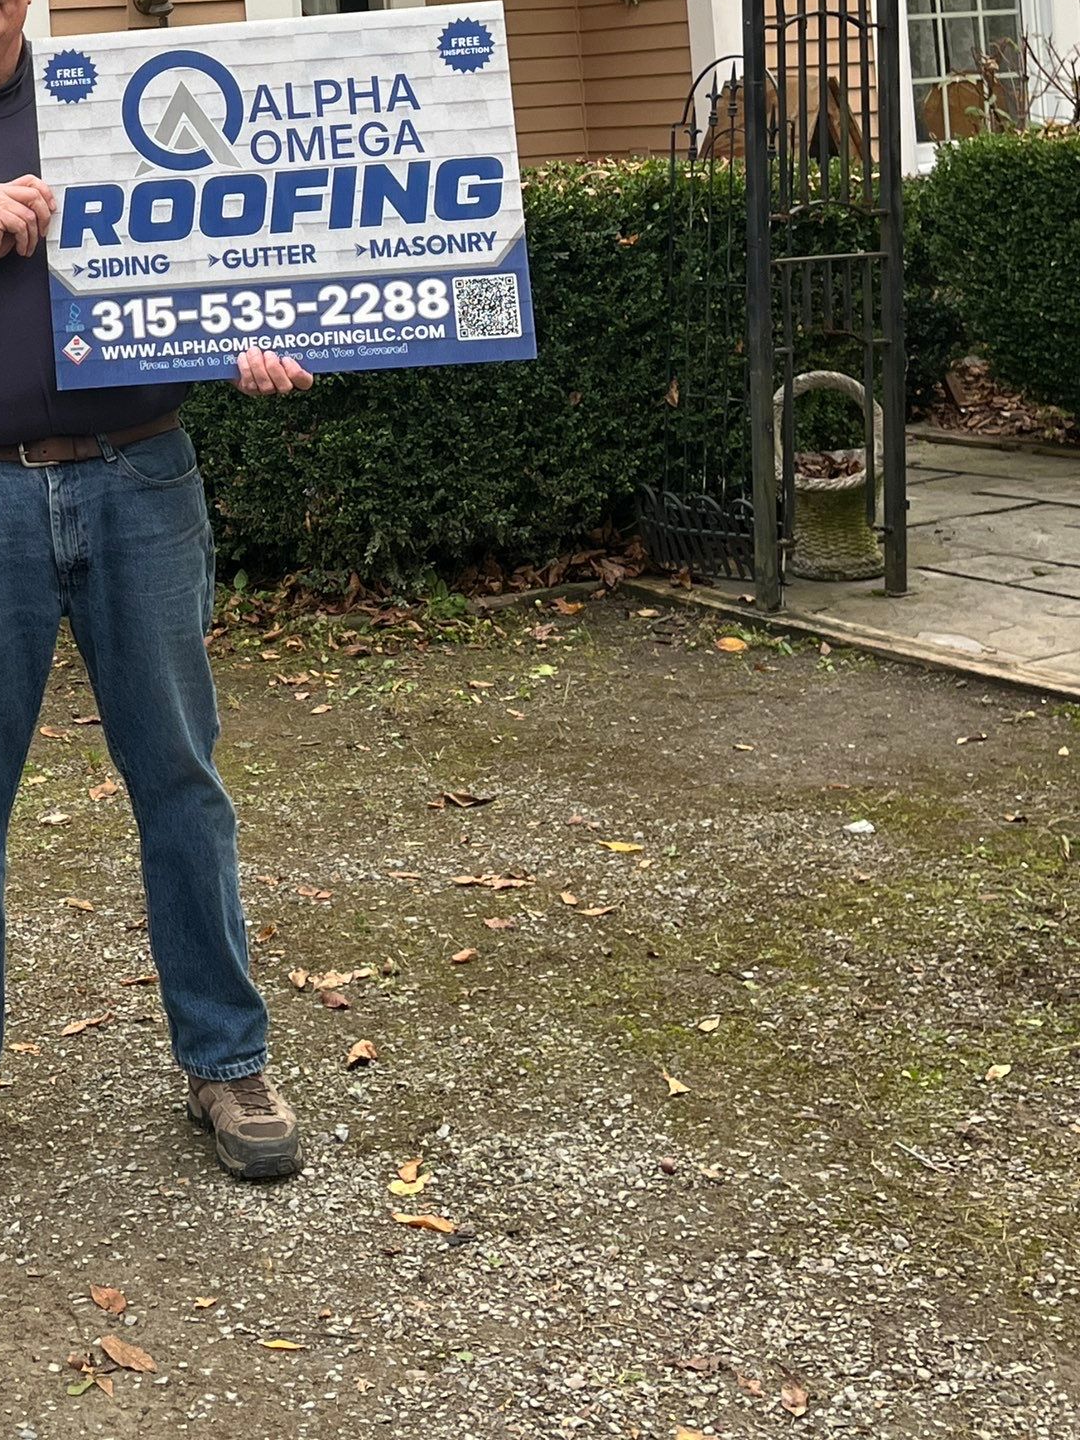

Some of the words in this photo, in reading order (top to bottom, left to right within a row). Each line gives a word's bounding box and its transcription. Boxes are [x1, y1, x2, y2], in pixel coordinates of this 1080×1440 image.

[443, 46, 490, 57] INSPECTION
[451, 36, 480, 48] FREE
[50, 77, 91, 87] ESTIMATES
[56, 67, 84, 79] FREE
[248, 73, 422, 123] ALPHA
[249, 120, 425, 165] OMEGA
[58, 155, 504, 251] ROOFING
[87, 254, 171, 279] SIDING
[222, 244, 316, 270] GUTTER
[370, 231, 498, 260] MASONRY
[91, 279, 451, 342] 315-535-2288
[139, 360, 170, 371] From
[173, 356, 205, 368] Start
[207, 356, 221, 366] to
[306, 348, 329, 359] Got
[331, 347, 355, 358] You
[357, 343, 408, 356] Covered
